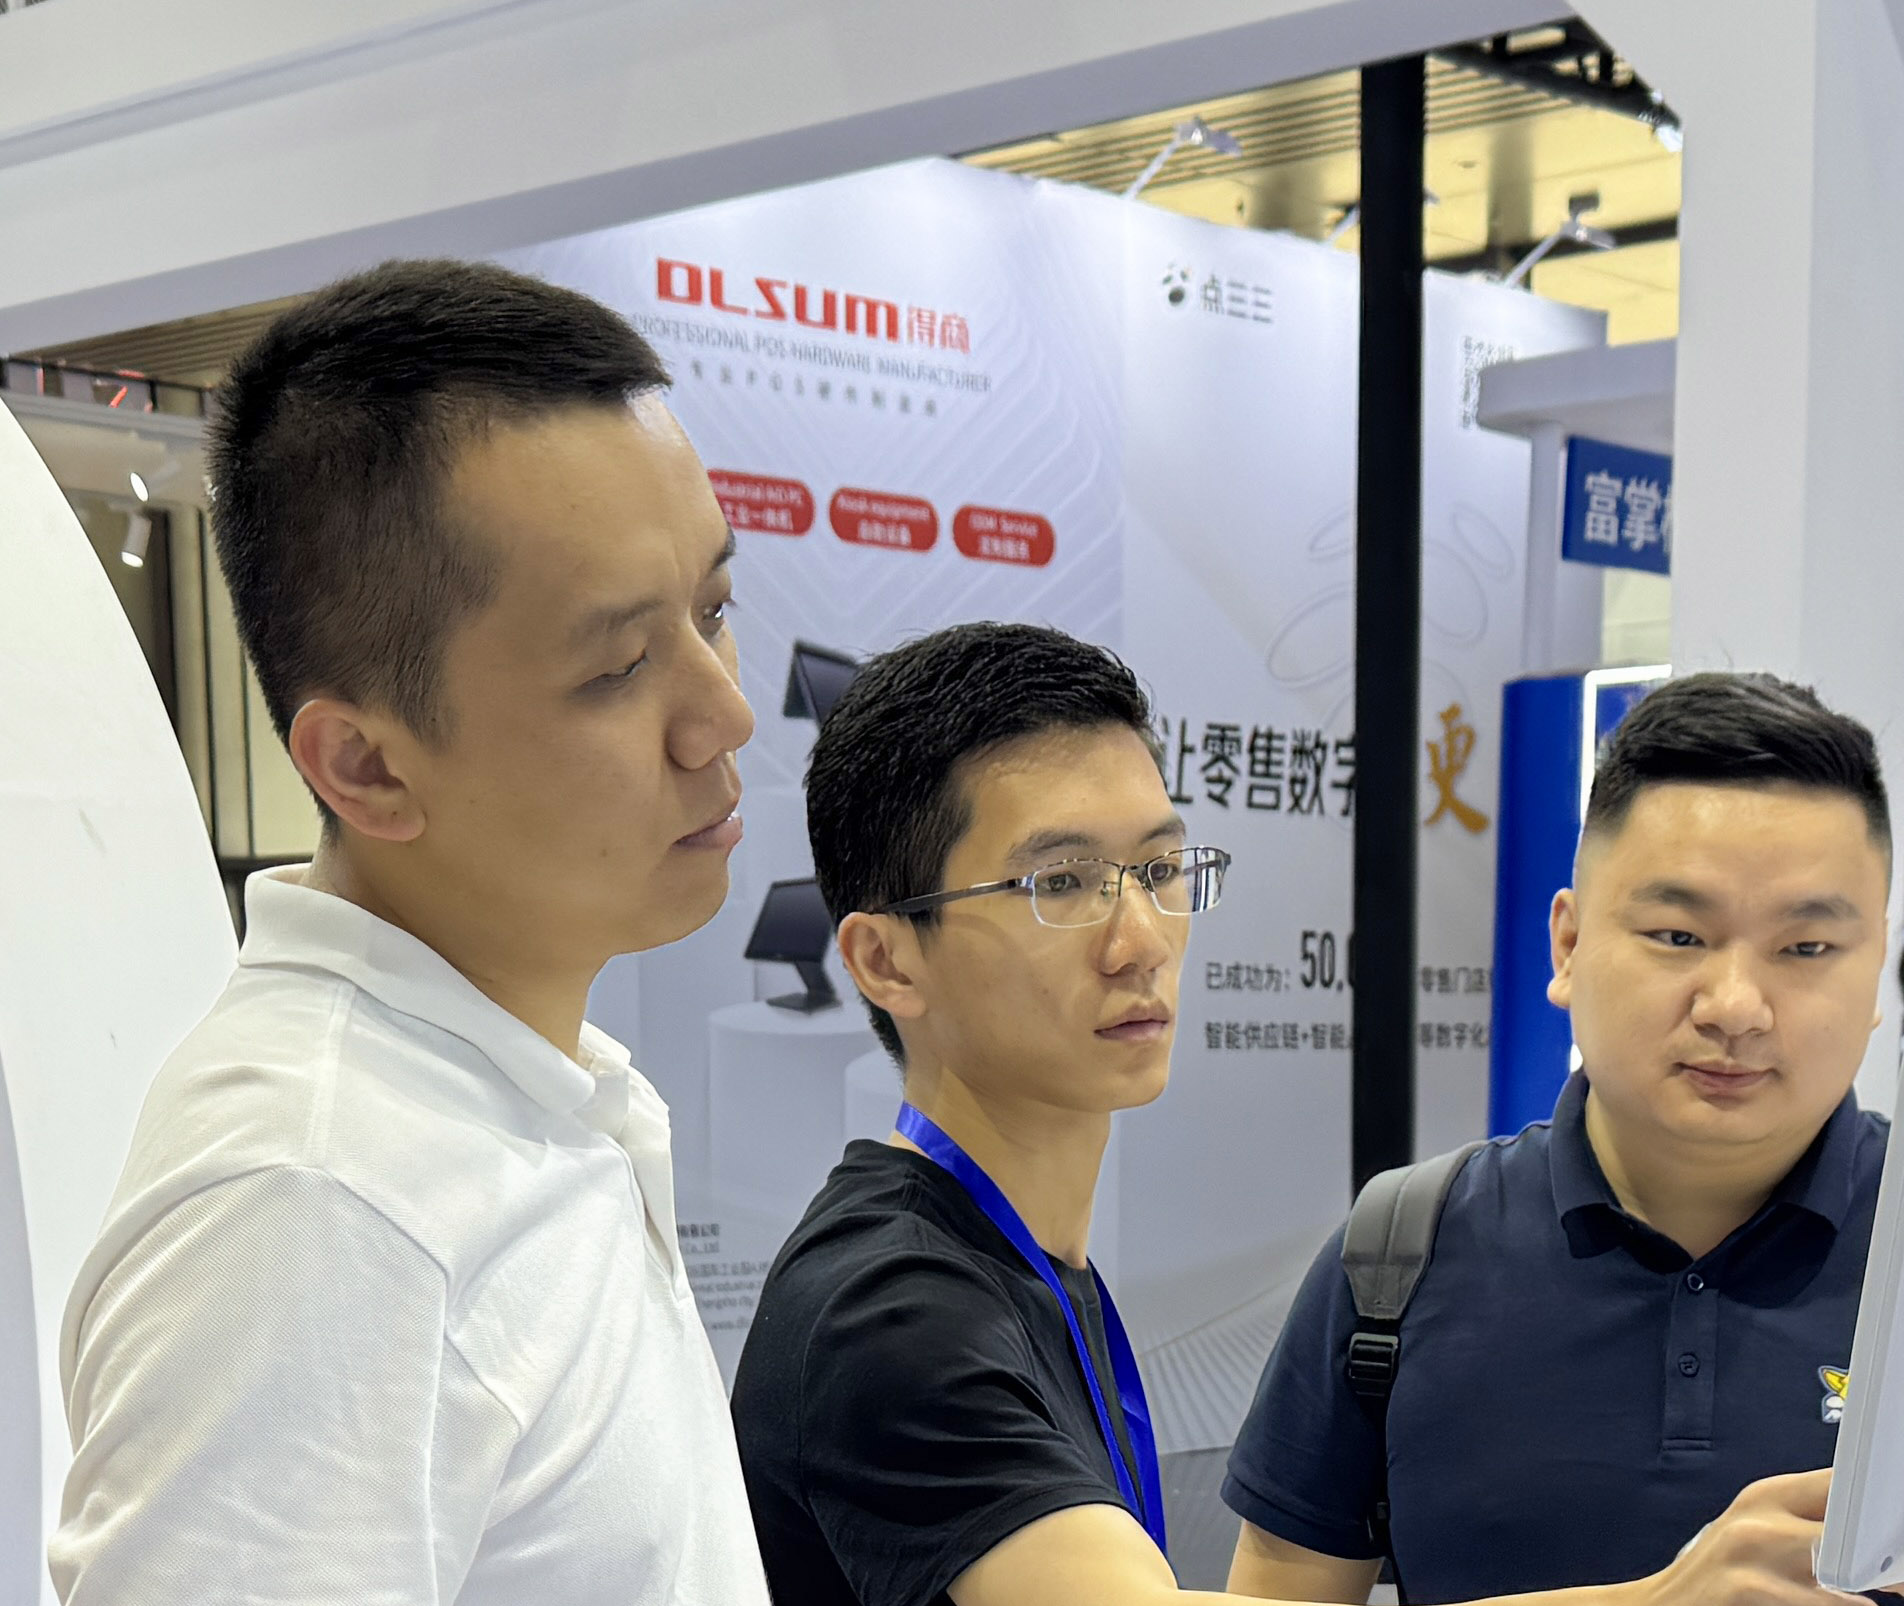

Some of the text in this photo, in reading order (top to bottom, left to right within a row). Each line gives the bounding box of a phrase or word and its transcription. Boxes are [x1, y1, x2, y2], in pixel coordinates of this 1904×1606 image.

[1205, 1021, 1352, 1050] 智能供应链+智能
